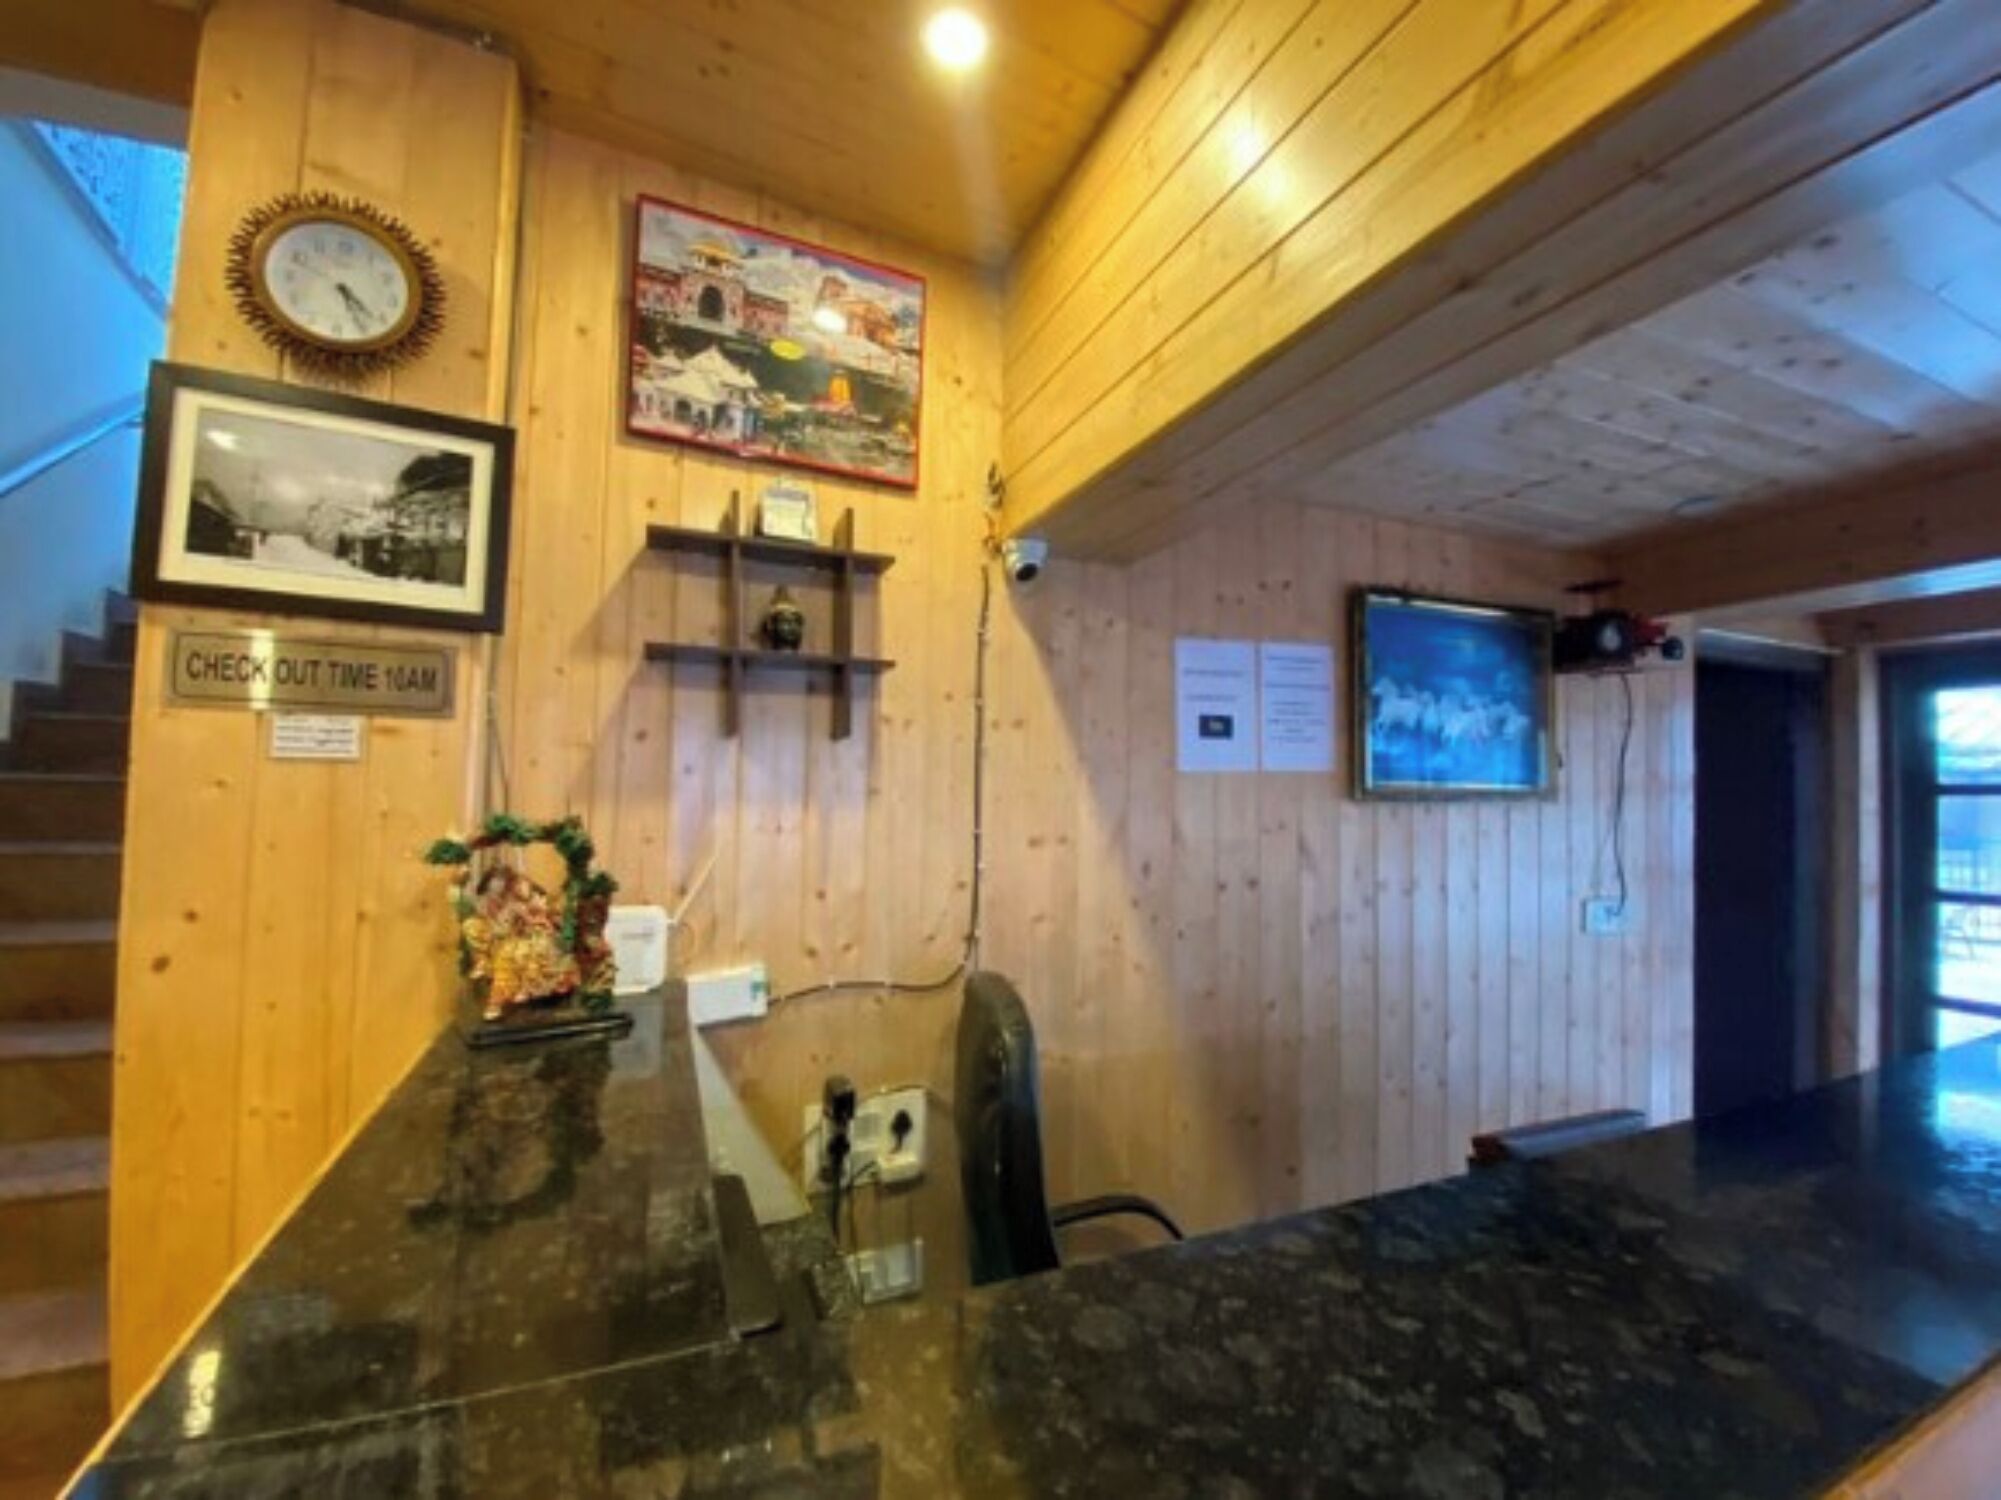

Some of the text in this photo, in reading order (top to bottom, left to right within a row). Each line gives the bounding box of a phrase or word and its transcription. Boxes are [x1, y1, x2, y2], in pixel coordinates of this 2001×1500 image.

[186, 651, 437, 692] CHECK OUT TIME 10AM
